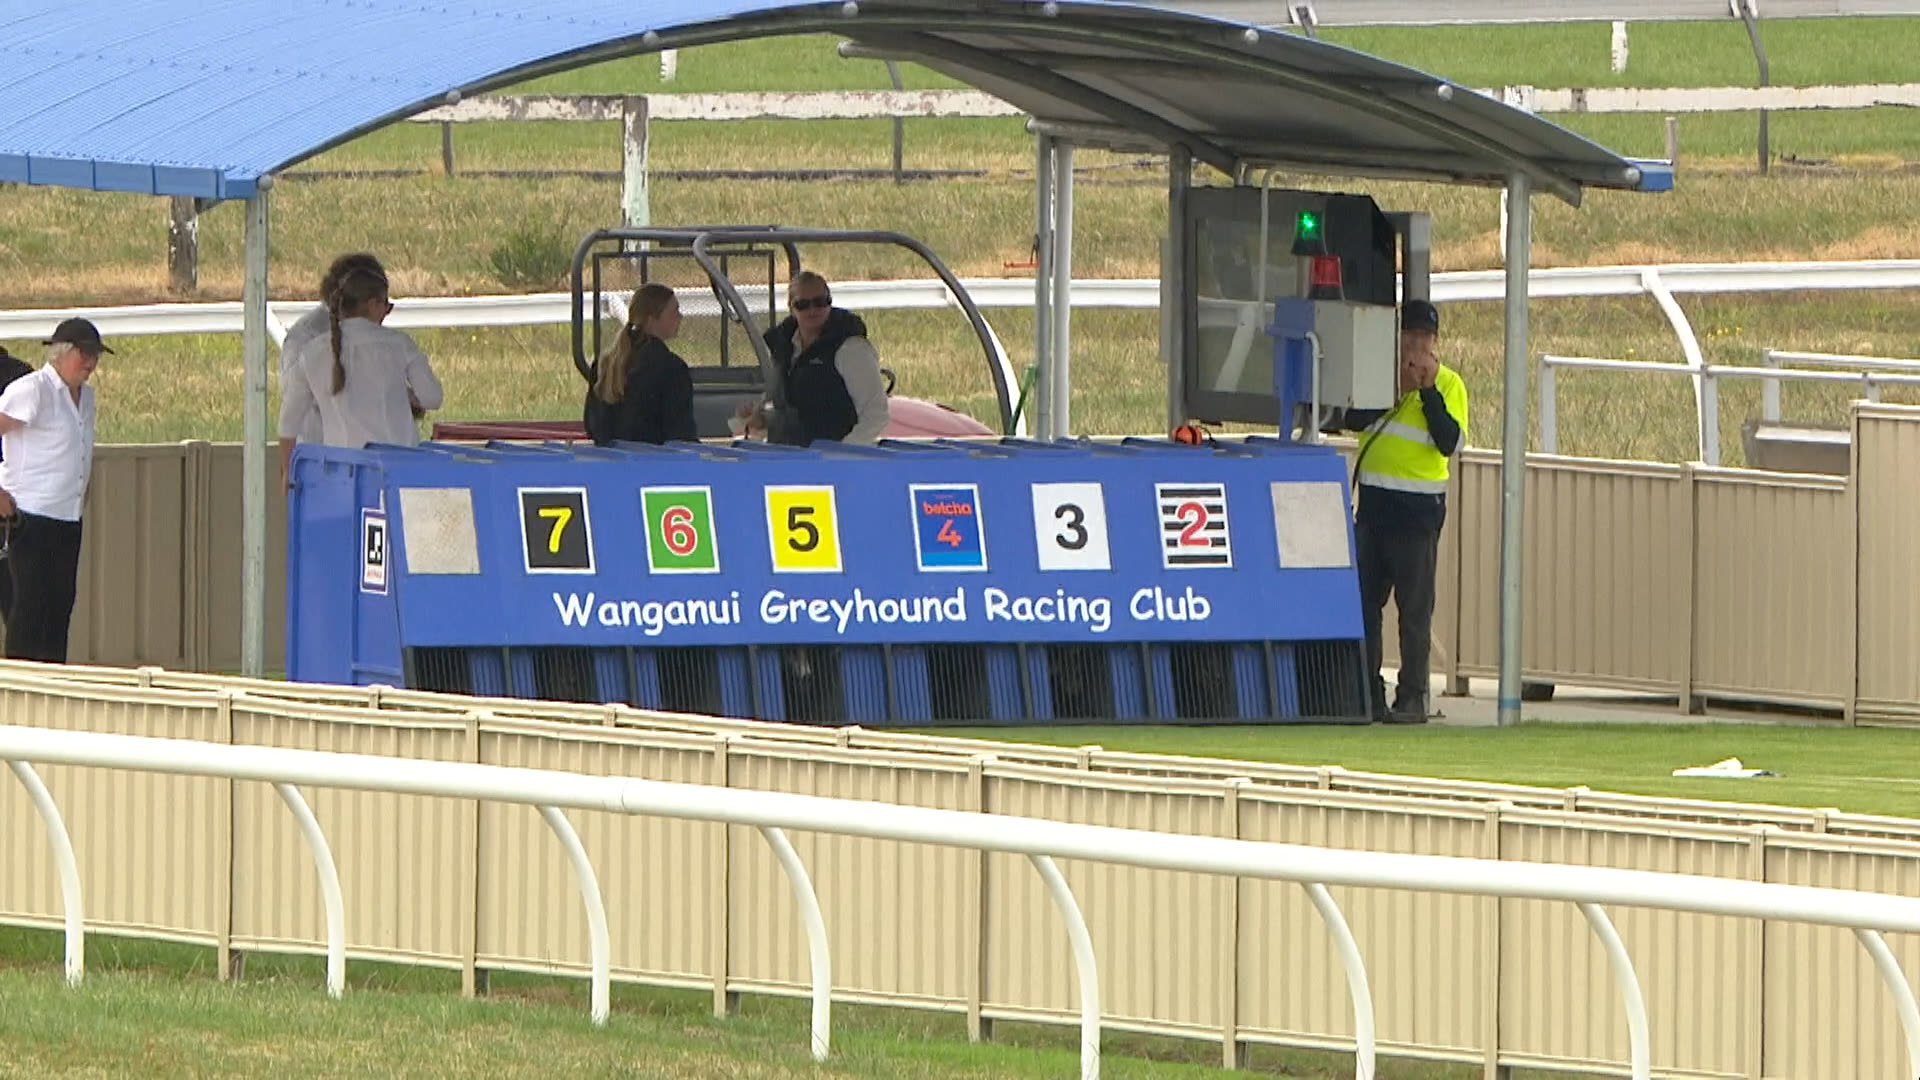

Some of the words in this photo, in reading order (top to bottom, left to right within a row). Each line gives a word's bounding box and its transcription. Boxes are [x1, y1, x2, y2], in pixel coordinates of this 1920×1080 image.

[537, 507, 572, 553] 7
[660, 505, 699, 556] 6
[787, 506, 820, 552] 5
[923, 501, 973, 515] betcha
[1054, 503, 1089, 550] 3
[1176, 502, 1210, 547] 2
[937, 519, 962, 547] 4
[553, 591, 741, 636] Wanganui
[760, 587, 967, 634] Greyhound
[984, 587, 1111, 633] Racing
[1129, 586, 1211, 621] Club
